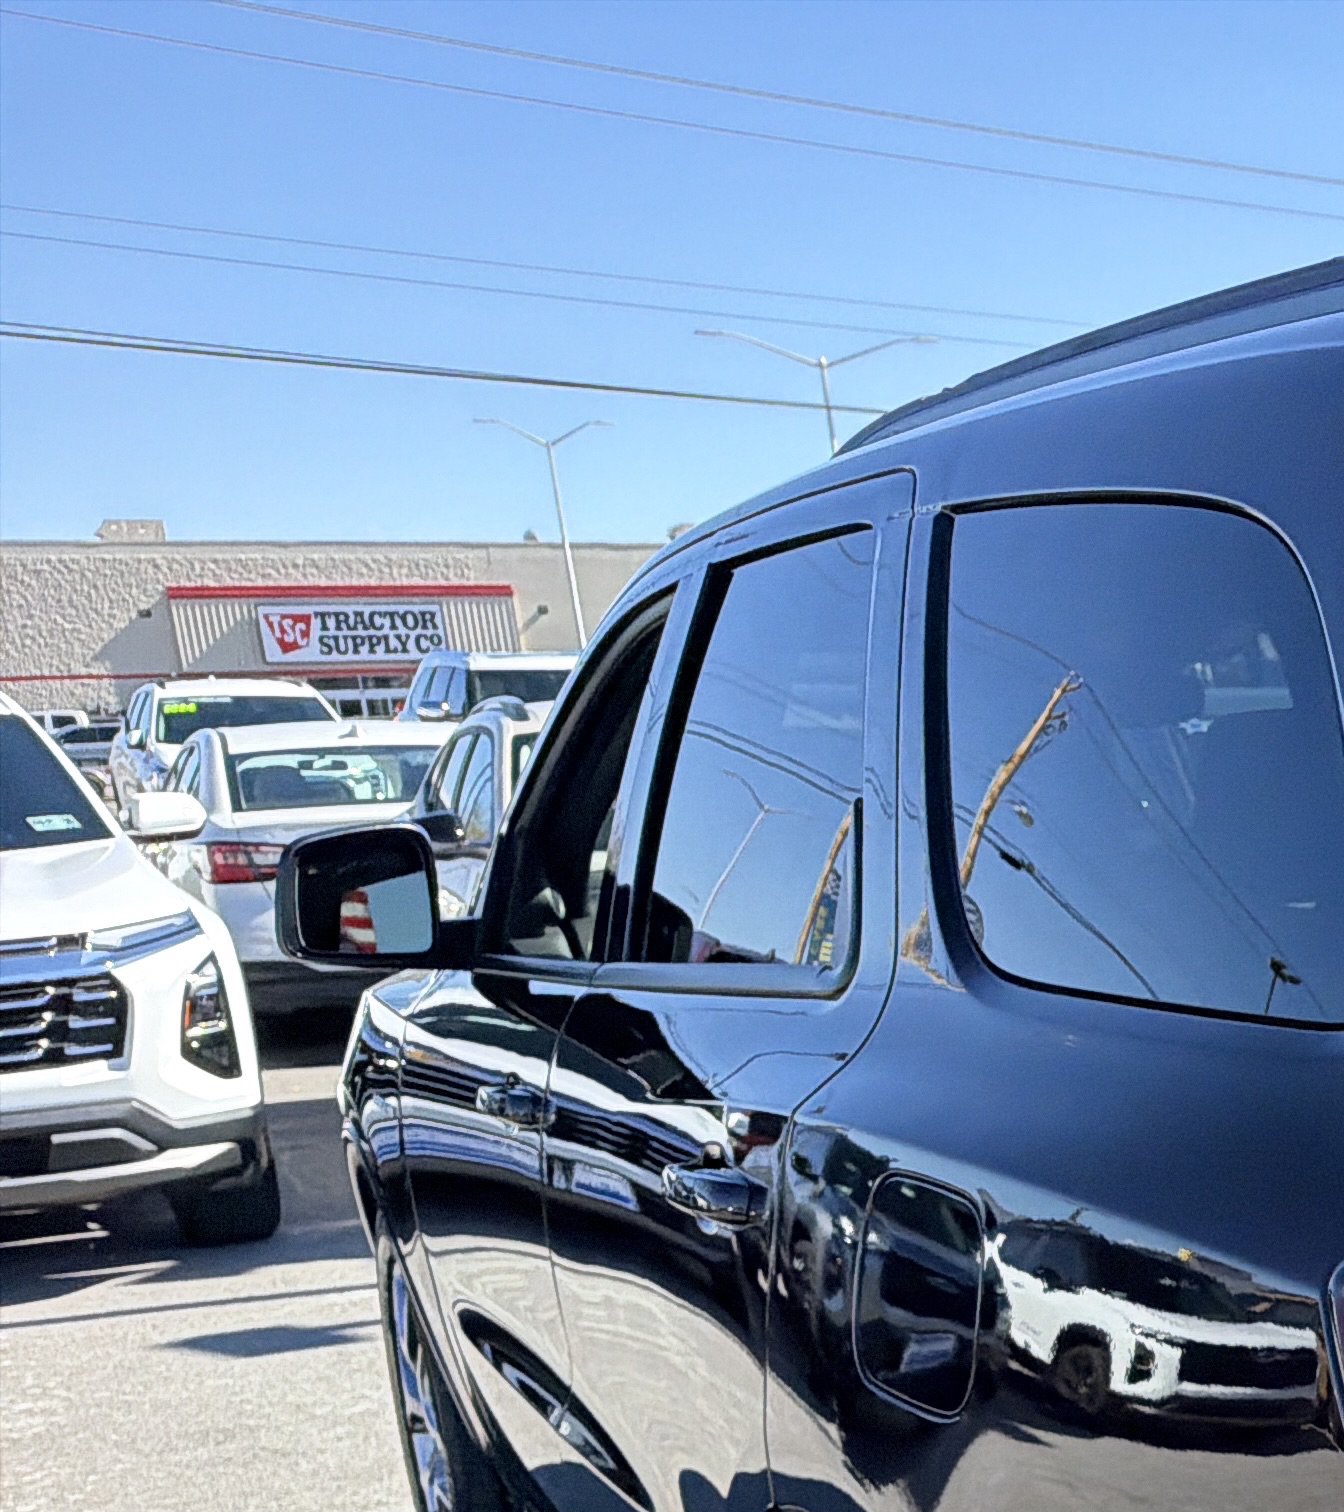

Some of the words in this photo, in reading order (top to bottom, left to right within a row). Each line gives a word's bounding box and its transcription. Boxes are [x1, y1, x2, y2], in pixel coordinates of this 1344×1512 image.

[267, 614, 308, 646] TSC
[313, 610, 440, 632] TRACTOR
[318, 633, 411, 656] SUPPLY
